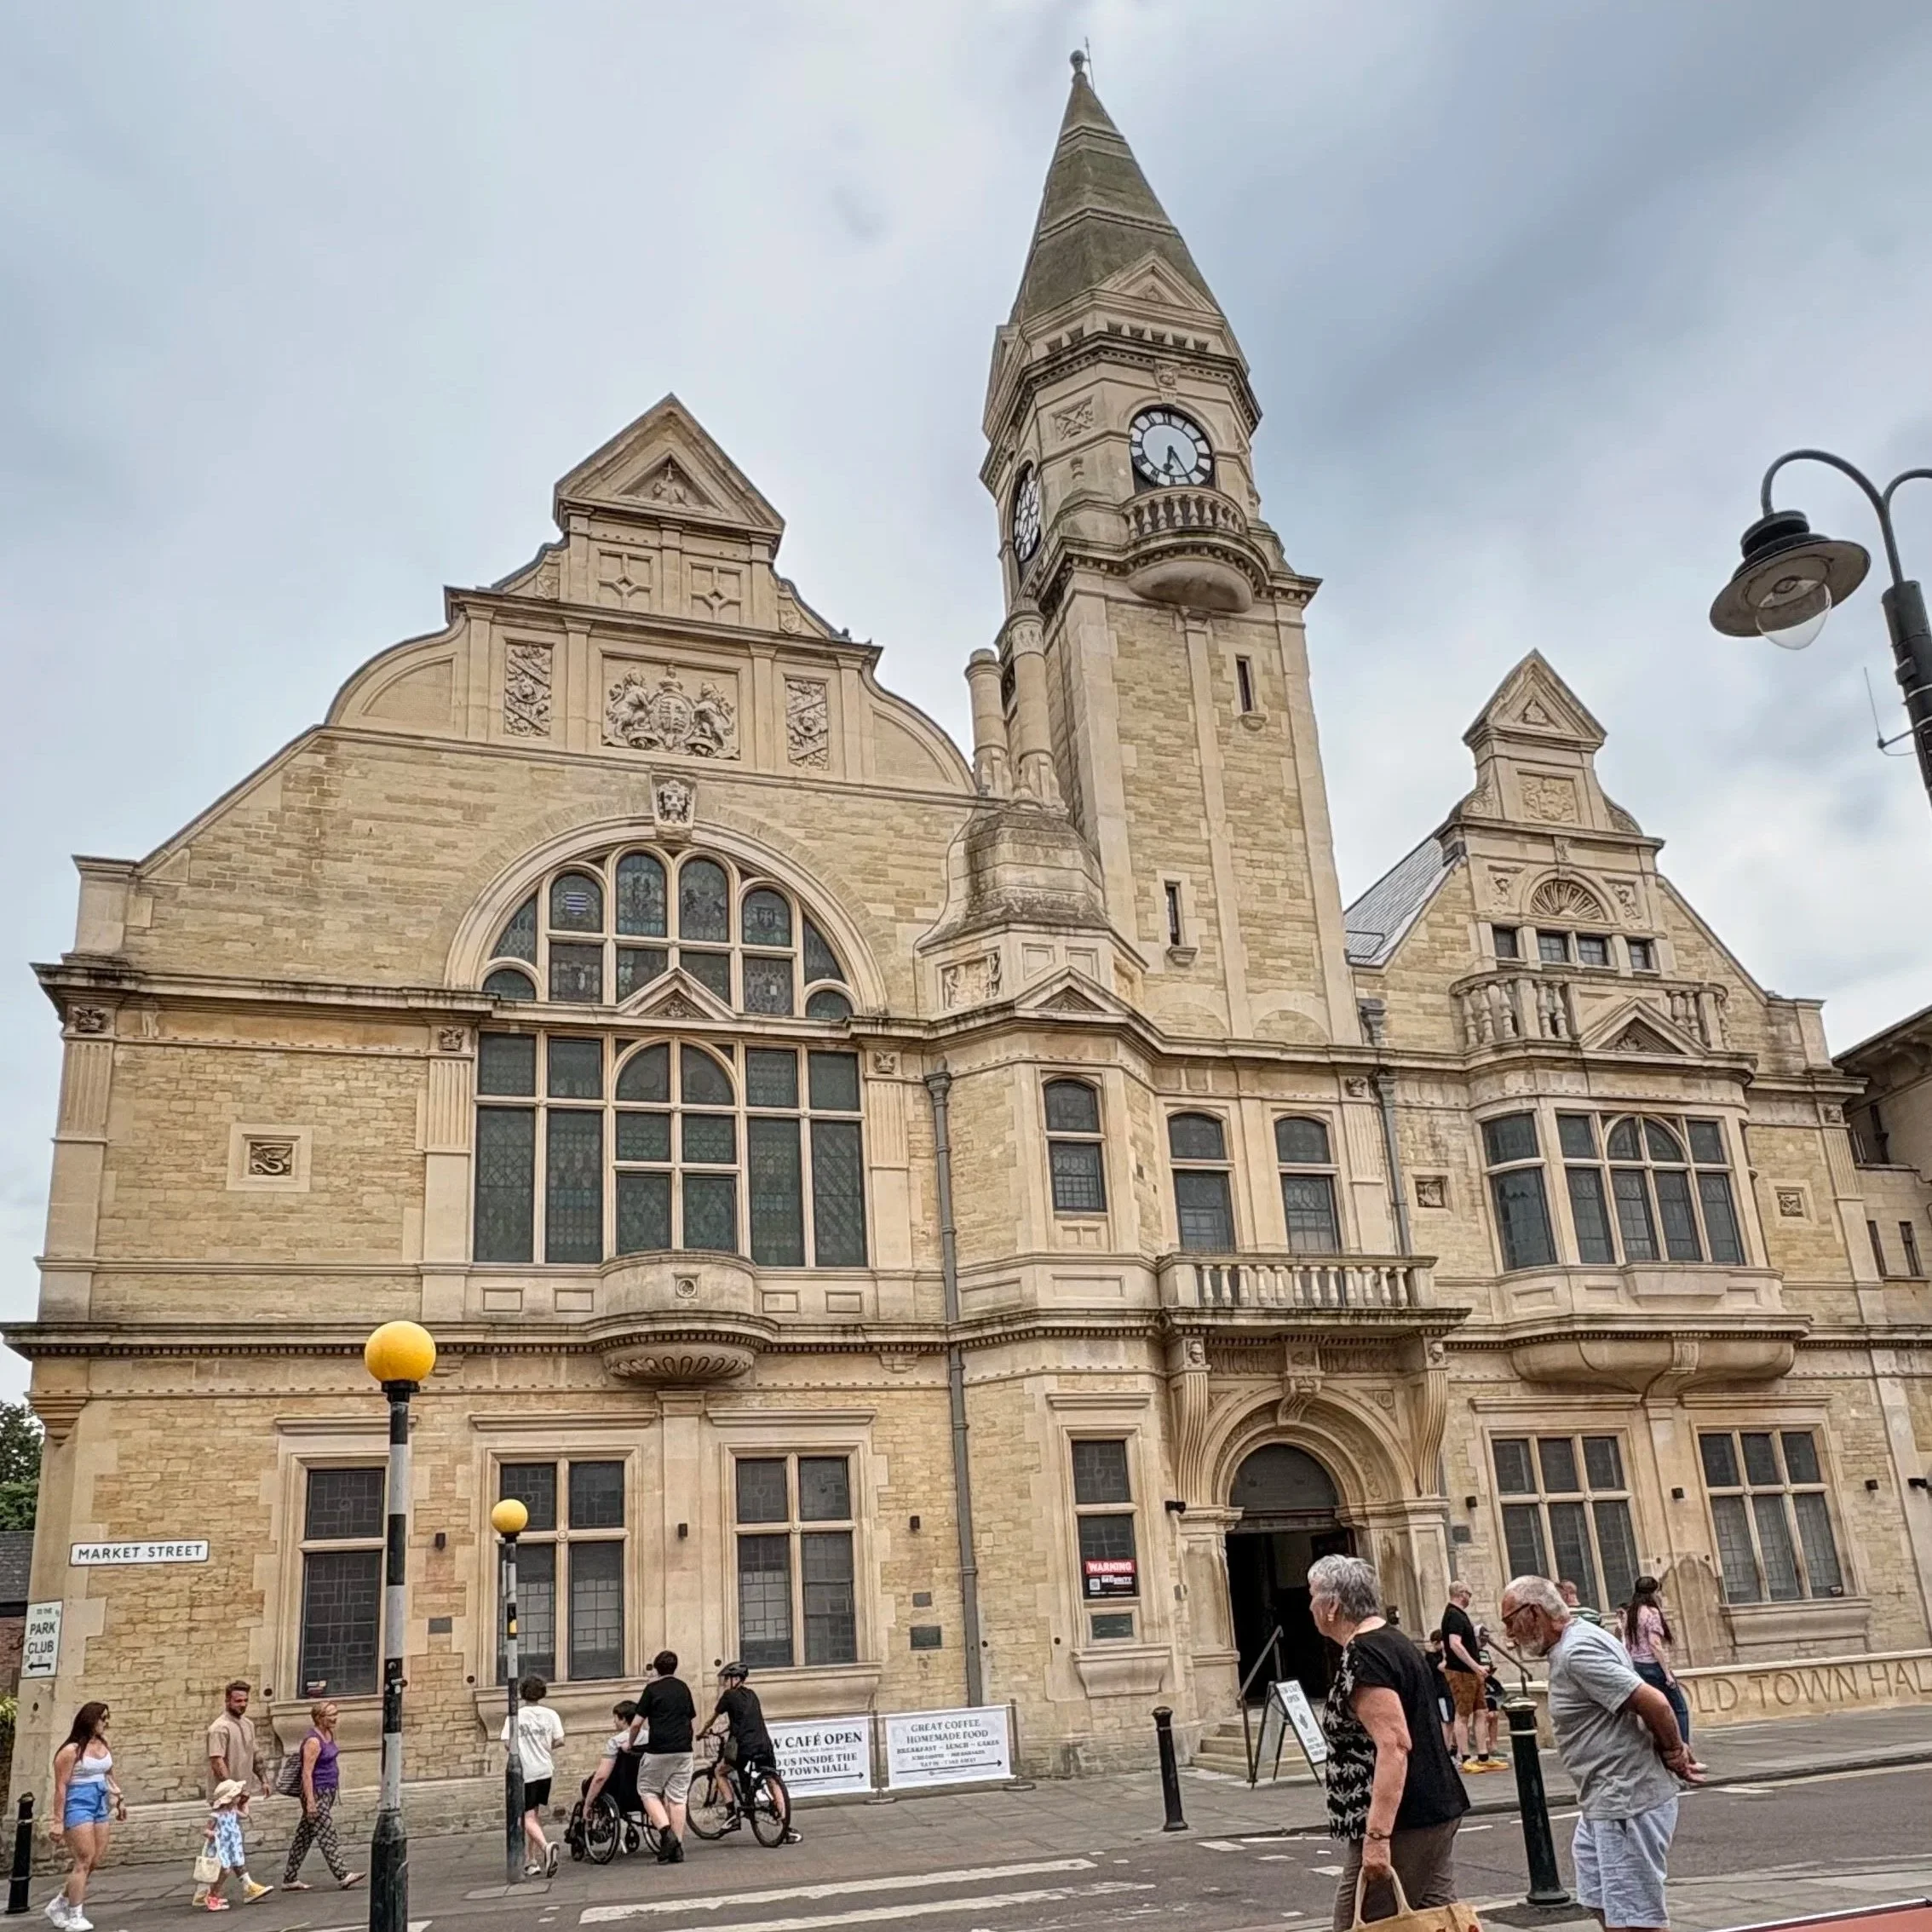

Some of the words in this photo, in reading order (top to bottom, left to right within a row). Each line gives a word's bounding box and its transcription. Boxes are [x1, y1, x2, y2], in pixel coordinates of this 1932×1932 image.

[78, 1546, 141, 1560] MARKET
[147, 1544, 203, 1558] STREET
[1088, 1561, 1132, 1572] WARNING
[29, 1621, 56, 1636] PARK
[27, 1639, 55, 1654] CLUB
[1747, 1666, 1860, 1709] TOWN
[1866, 1659, 1932, 1699] HAL
[910, 1722, 943, 1733] GREAT
[944, 1719, 981, 1730] COFFEE
[785, 1731, 822, 1749] CAFÉ
[824, 1730, 863, 1745] OPEN
[906, 1732, 961, 1745] HOMEMADE
[963, 1729, 989, 1739] FOOD
[784, 1757, 797, 1768] US
[798, 1754, 835, 1766] INSIDE
[836, 1752, 858, 1762] THE
[789, 1765, 820, 1777] TOWN
[821, 1762, 850, 1774] HALL
